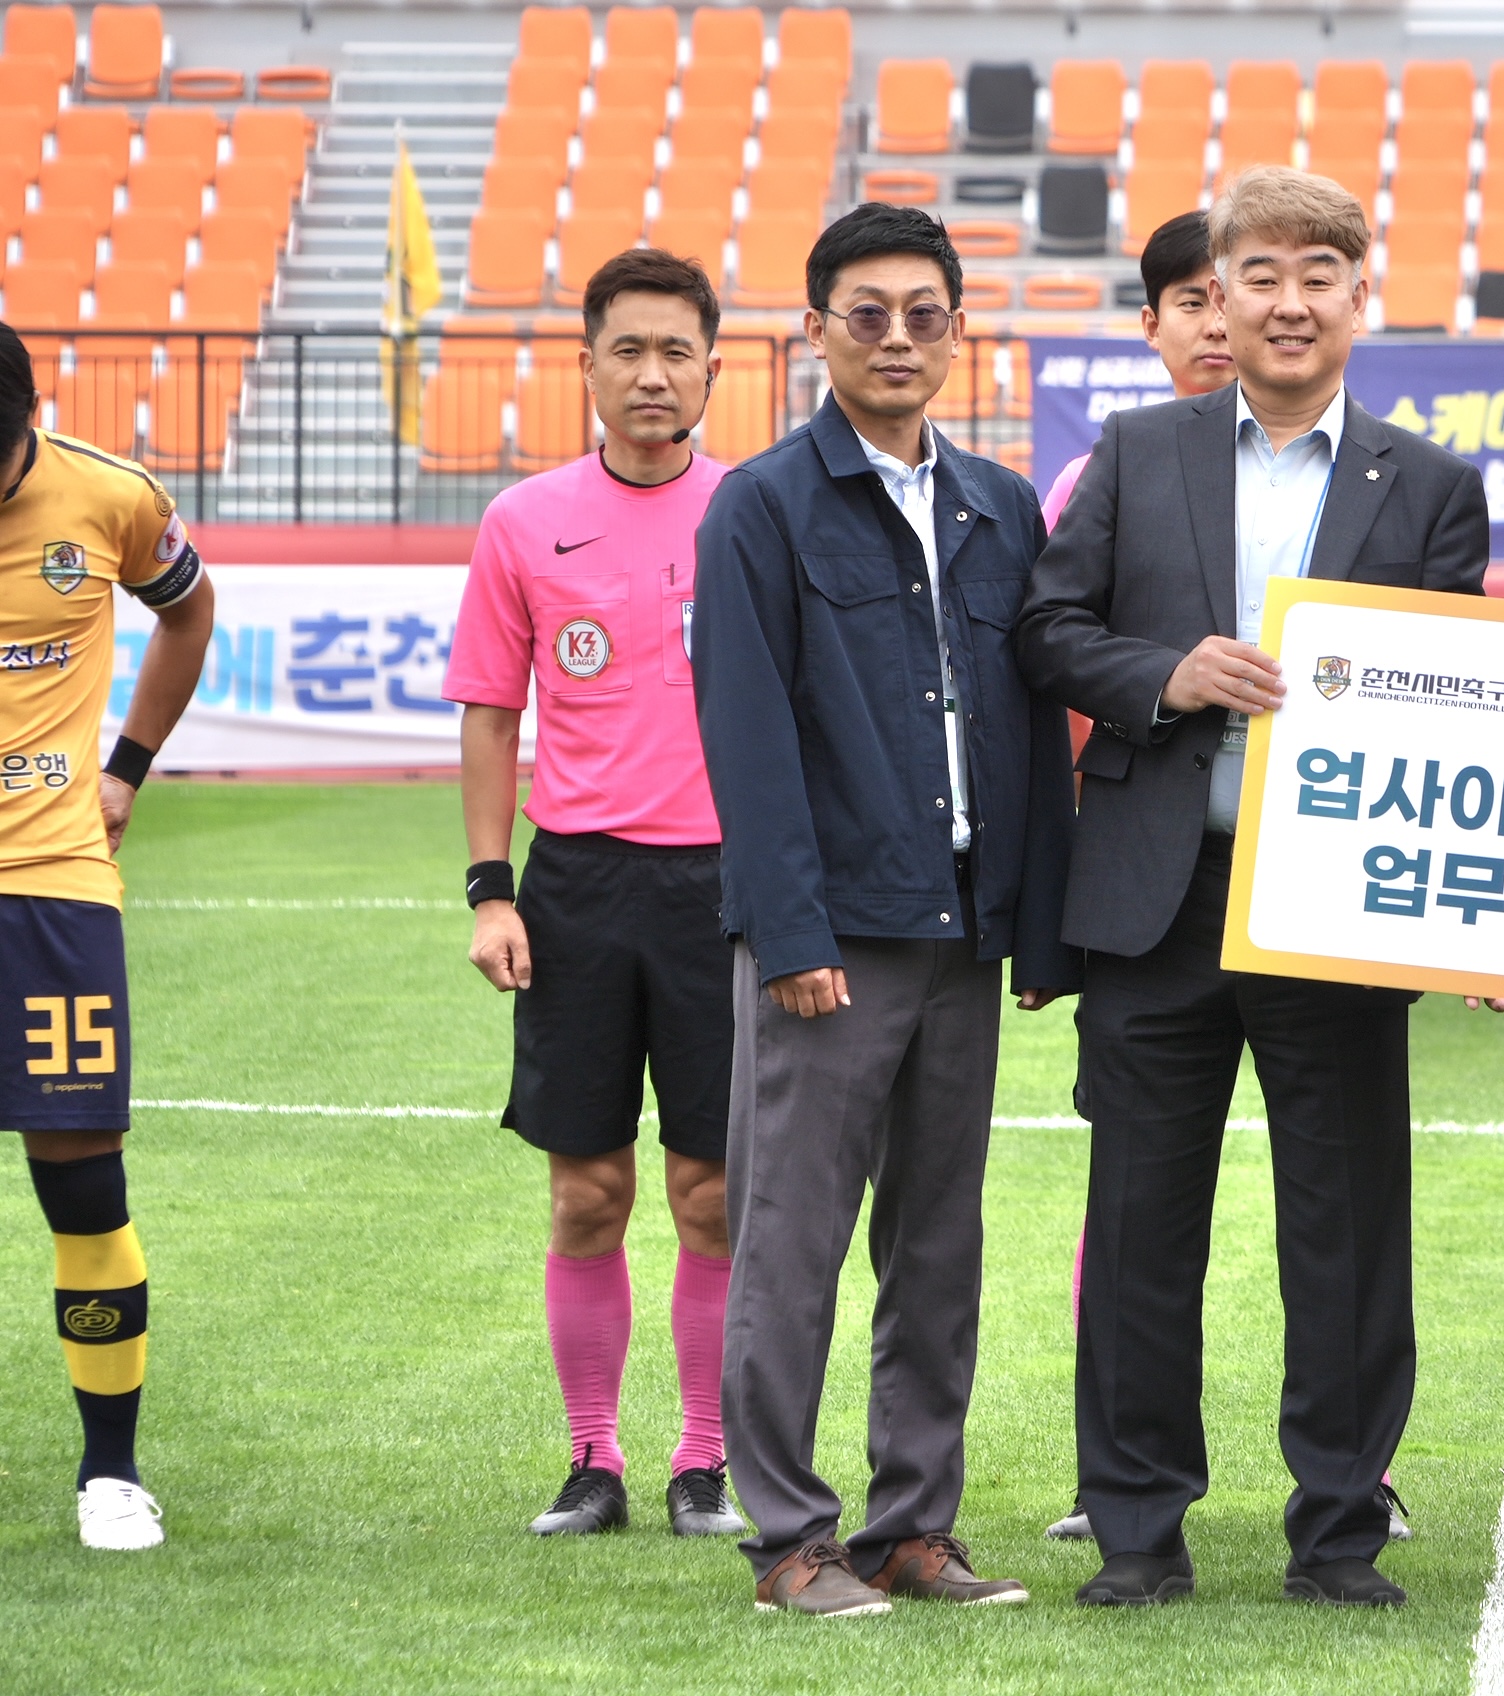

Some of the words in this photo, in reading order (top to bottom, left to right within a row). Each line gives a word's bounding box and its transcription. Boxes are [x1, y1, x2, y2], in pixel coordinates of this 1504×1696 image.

[288, 611, 457, 713] 춘천
[569, 658, 597, 666] LEAGUE
[1358, 690, 1415, 703] CHUNCHEON
[1416, 695, 1458, 708] CITIZEN
[1221, 730, 1247, 744] UES
[0, 753, 69, 790] 은행
[24, 995, 116, 1075] 35
